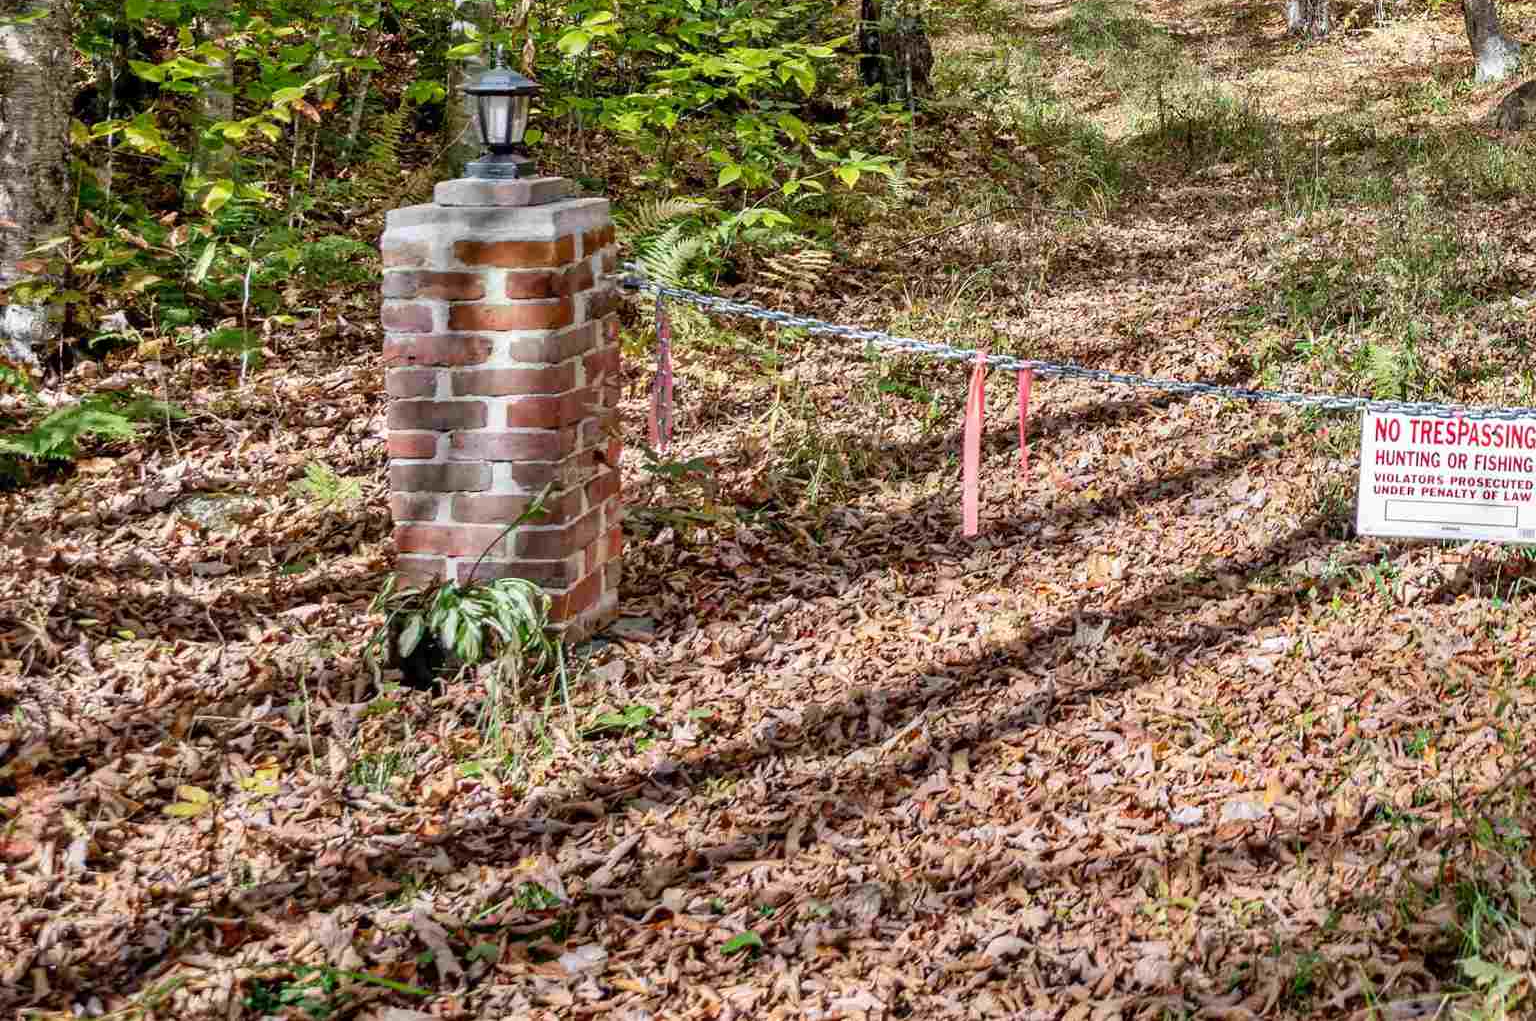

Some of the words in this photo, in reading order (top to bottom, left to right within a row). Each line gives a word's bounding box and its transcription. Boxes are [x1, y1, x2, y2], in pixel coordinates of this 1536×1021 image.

[1375, 418, 1400, 442] NO
[1410, 418, 1536, 450] TRESPASSING
[1375, 450, 1440, 467] HUNTING
[1448, 453, 1468, 470] OR
[1475, 454, 1534, 473] FISHING
[1374, 473, 1444, 485] VIOLATORS
[1450, 477, 1534, 490] PROSECUTED
[1374, 485, 1414, 496] UNDER
[1421, 487, 1476, 499] PENALTY
[1482, 490, 1499, 500] OF
[1503, 492, 1532, 502] LAW
